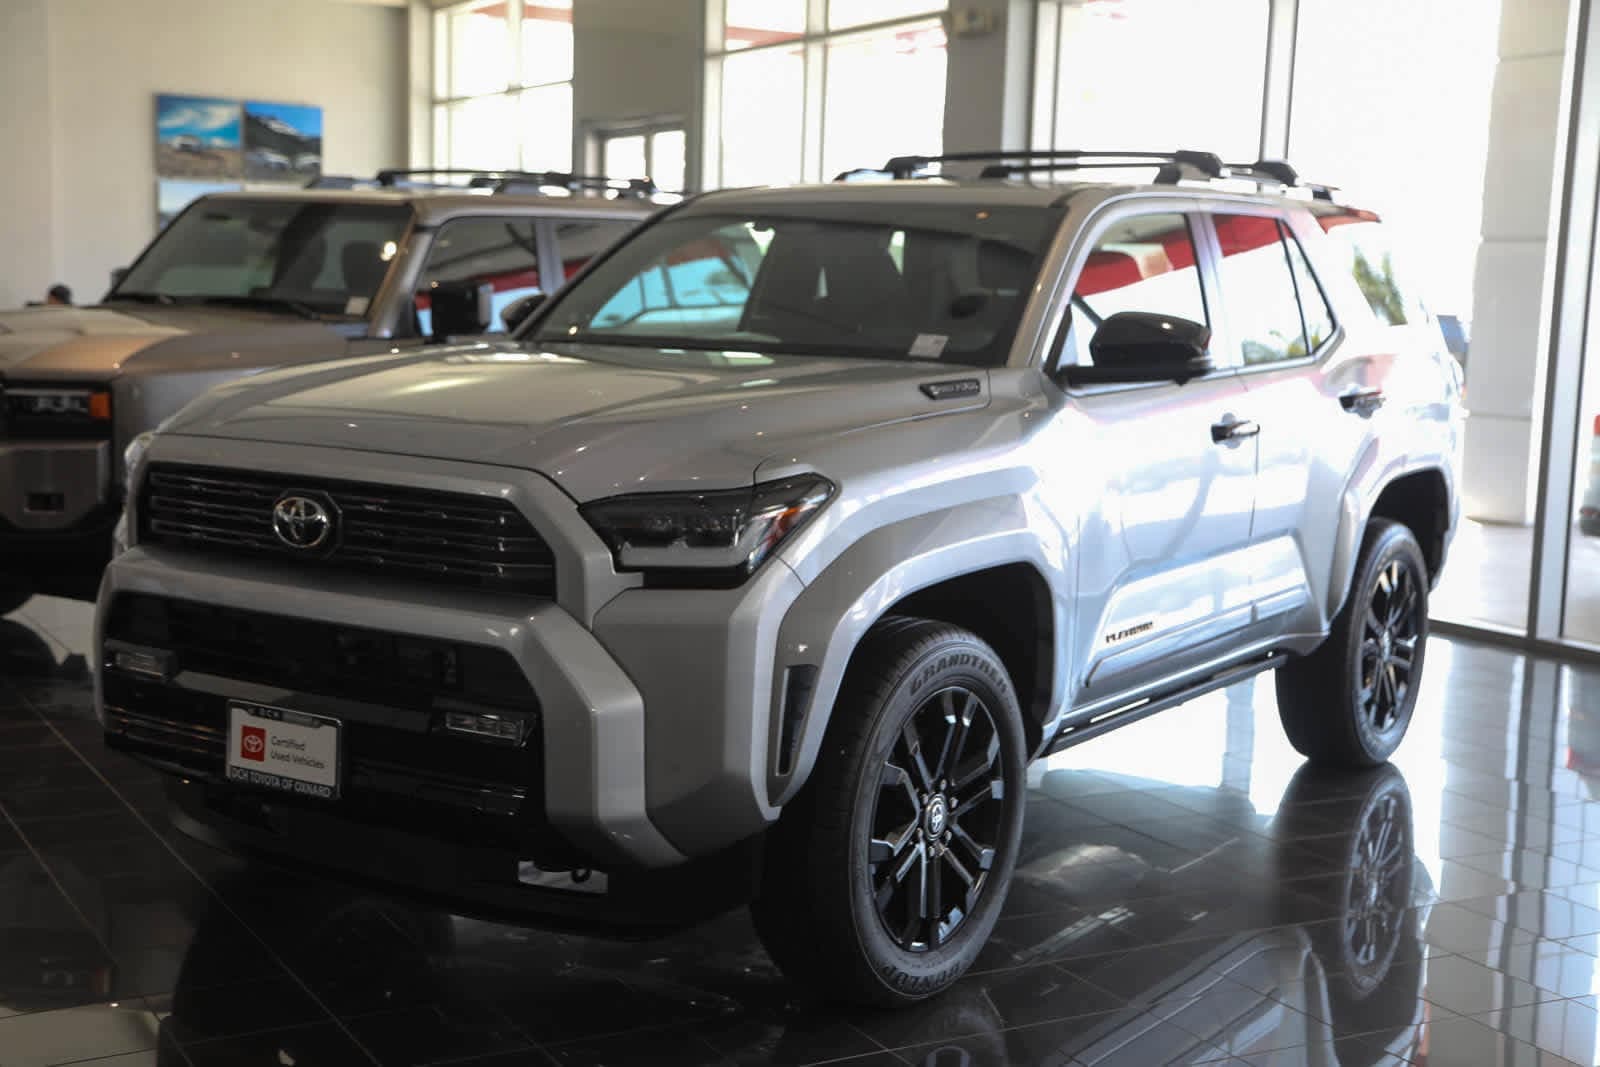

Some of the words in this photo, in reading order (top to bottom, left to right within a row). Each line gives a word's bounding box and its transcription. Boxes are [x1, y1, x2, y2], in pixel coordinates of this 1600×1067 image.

[270, 736, 306, 751] Certified
[270, 750, 292, 763] Used
[293, 753, 326, 769] Vehicles
[250, 770, 281, 786] TOYOTA
[281, 778, 293, 791] OF
[294, 782, 331, 798] OXNARD
